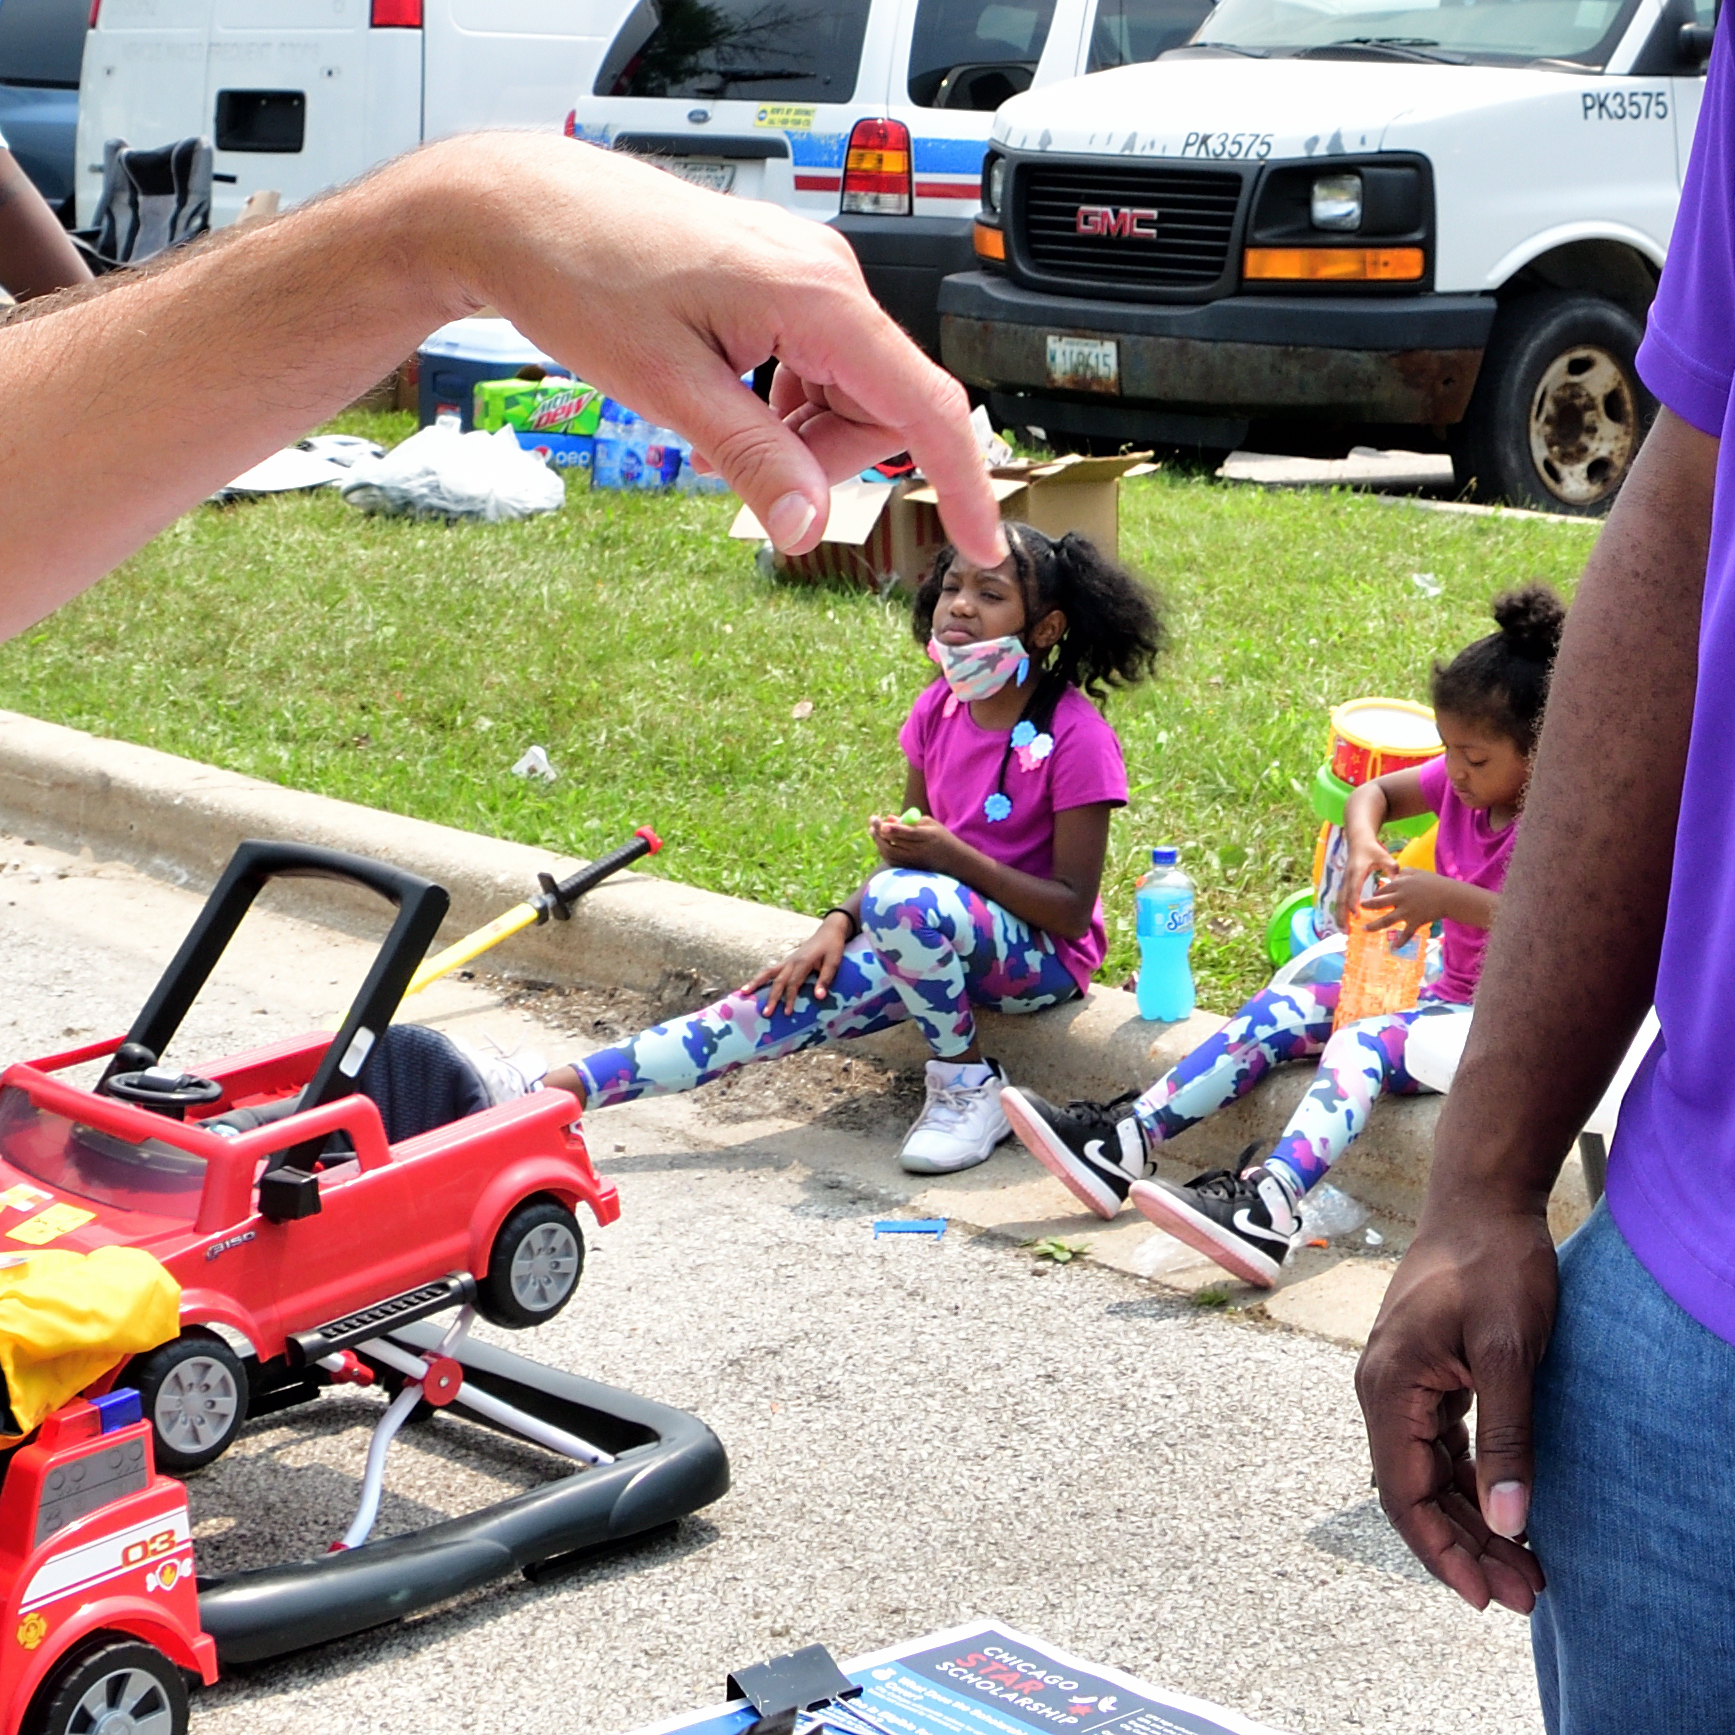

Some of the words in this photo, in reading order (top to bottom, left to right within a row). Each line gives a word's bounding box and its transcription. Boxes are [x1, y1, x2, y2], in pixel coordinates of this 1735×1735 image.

[1581, 91, 1669, 121] PK3575
[1181, 132, 1274, 159] PK3575
[1076, 205, 1158, 239] GMC
[122, 1529, 176, 1567] 03
[956, 1652, 1045, 1696] STAR
[983, 1646, 1079, 1691] CHICAGO
[935, 1661, 1079, 1726] SCHOLARSHIP
